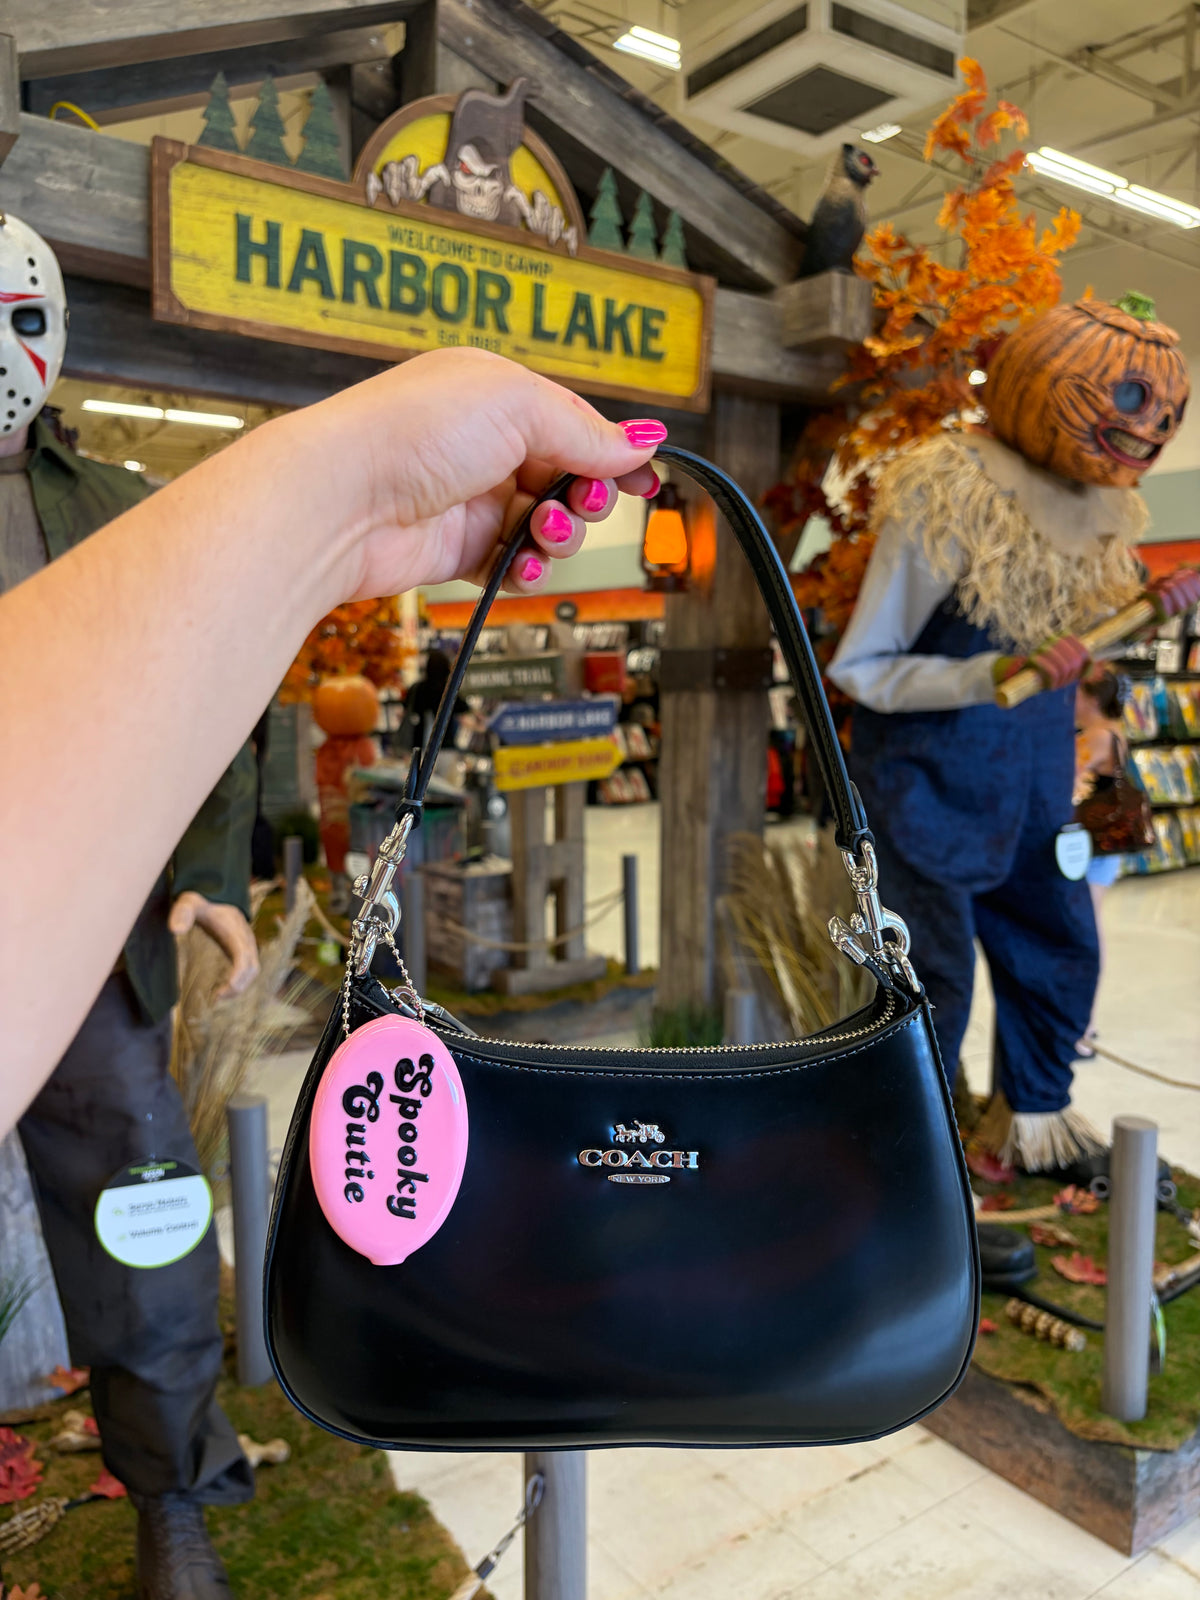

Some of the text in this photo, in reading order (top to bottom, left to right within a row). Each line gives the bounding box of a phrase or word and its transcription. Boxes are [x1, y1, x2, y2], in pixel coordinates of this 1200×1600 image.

[235, 212, 667, 362] HARBOR LAKE
[387, 224, 553, 277] WELCOME TO CAMP
[342, 1071, 384, 1204] Cutie
[386, 1053, 435, 1220] Spooky
[578, 1149, 699, 1169] COACH
[612, 1175, 666, 1183] NEW YORK
